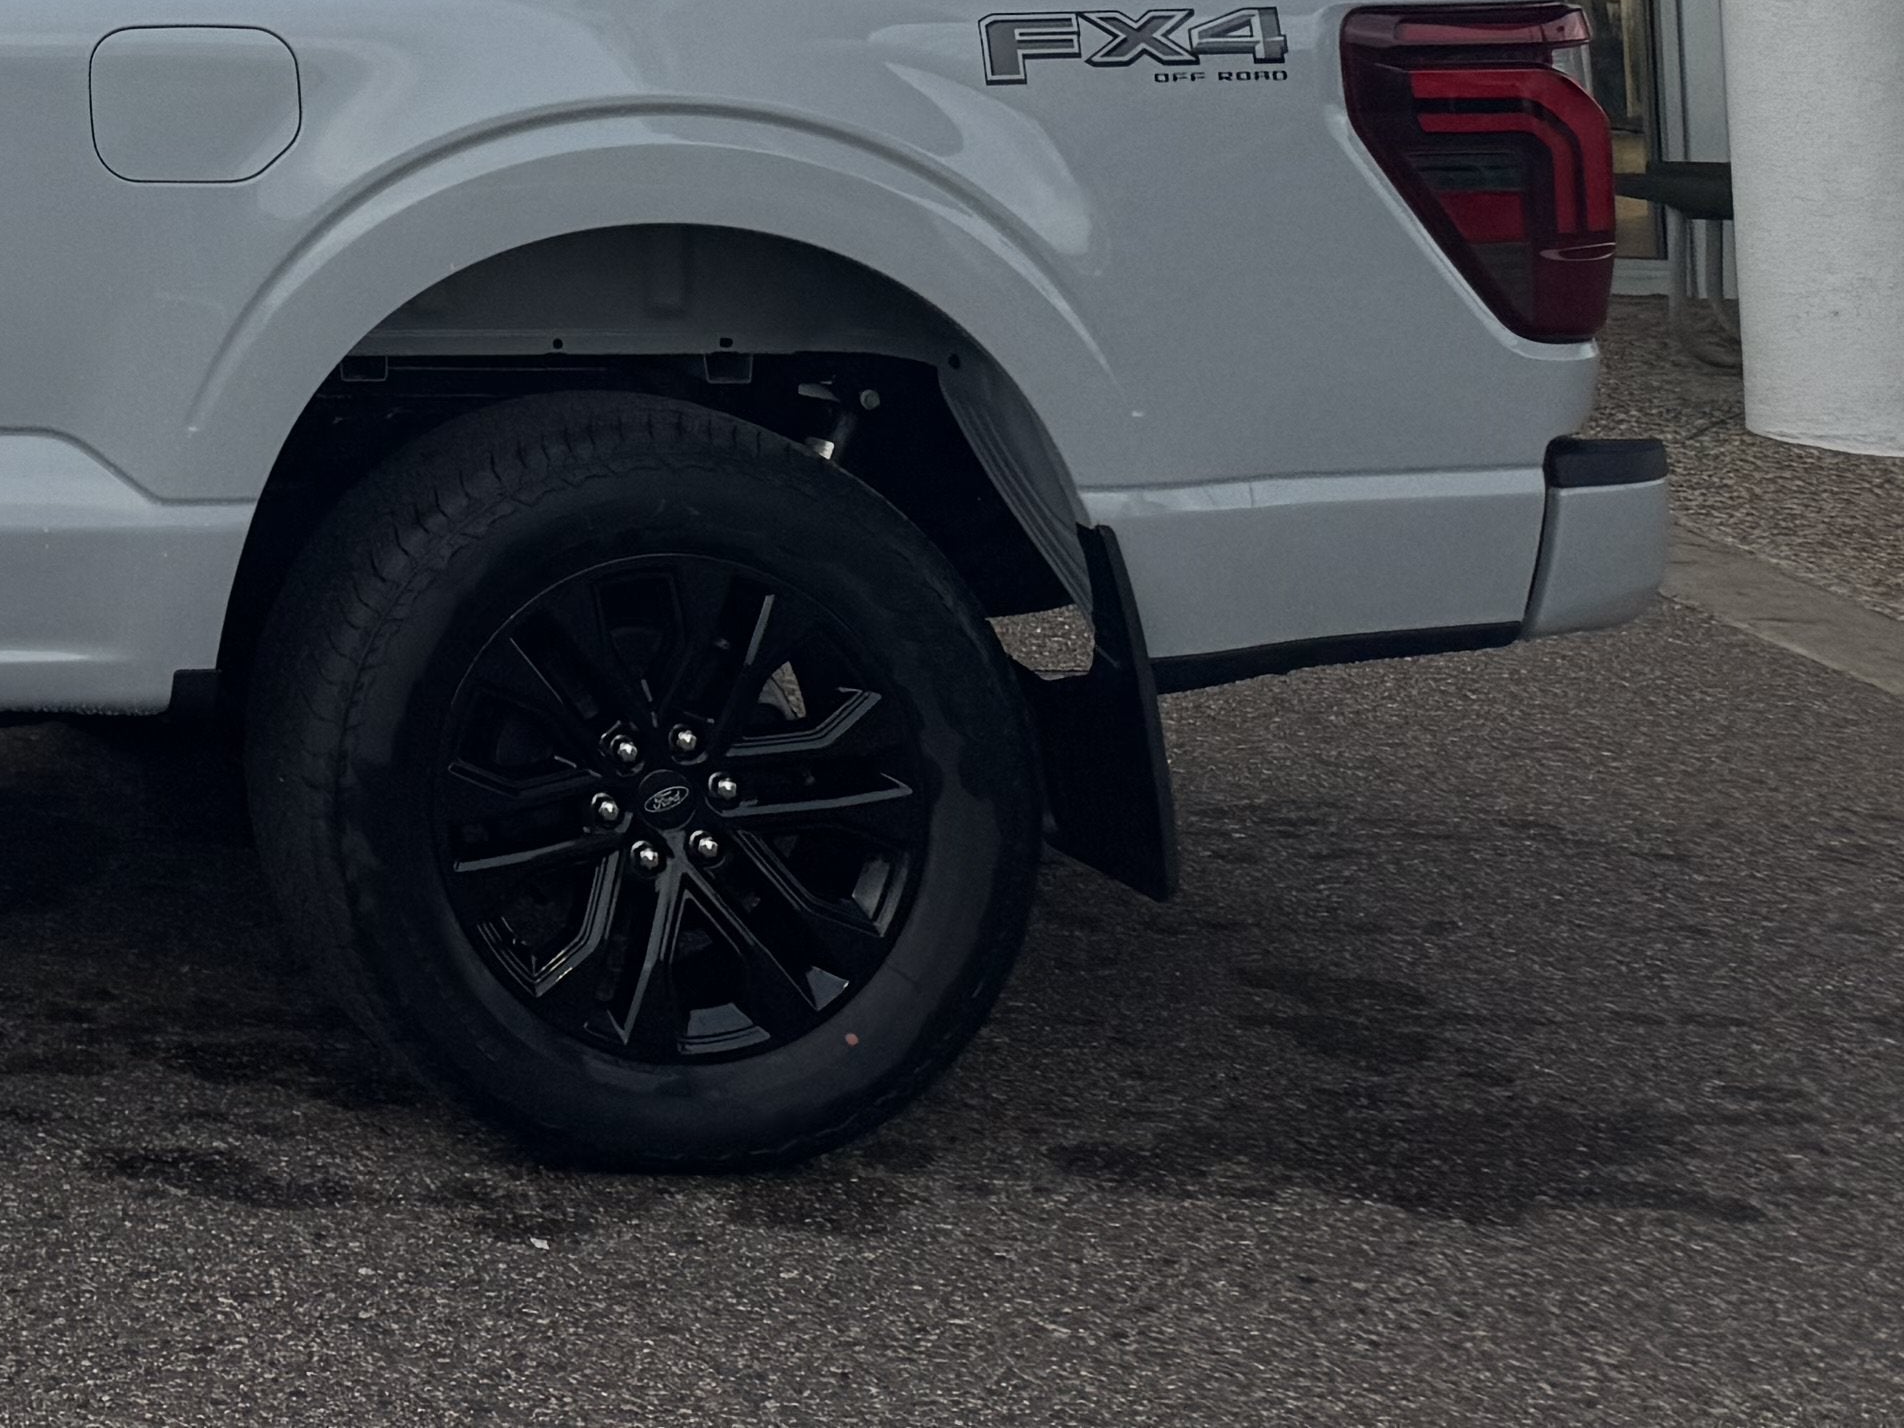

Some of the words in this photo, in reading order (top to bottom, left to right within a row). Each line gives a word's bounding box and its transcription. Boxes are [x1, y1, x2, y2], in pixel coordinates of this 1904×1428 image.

[977, 6, 1289, 86] FX4
[1153, 70, 1207, 84] OFF
[1217, 69, 1289, 83] ROAD
